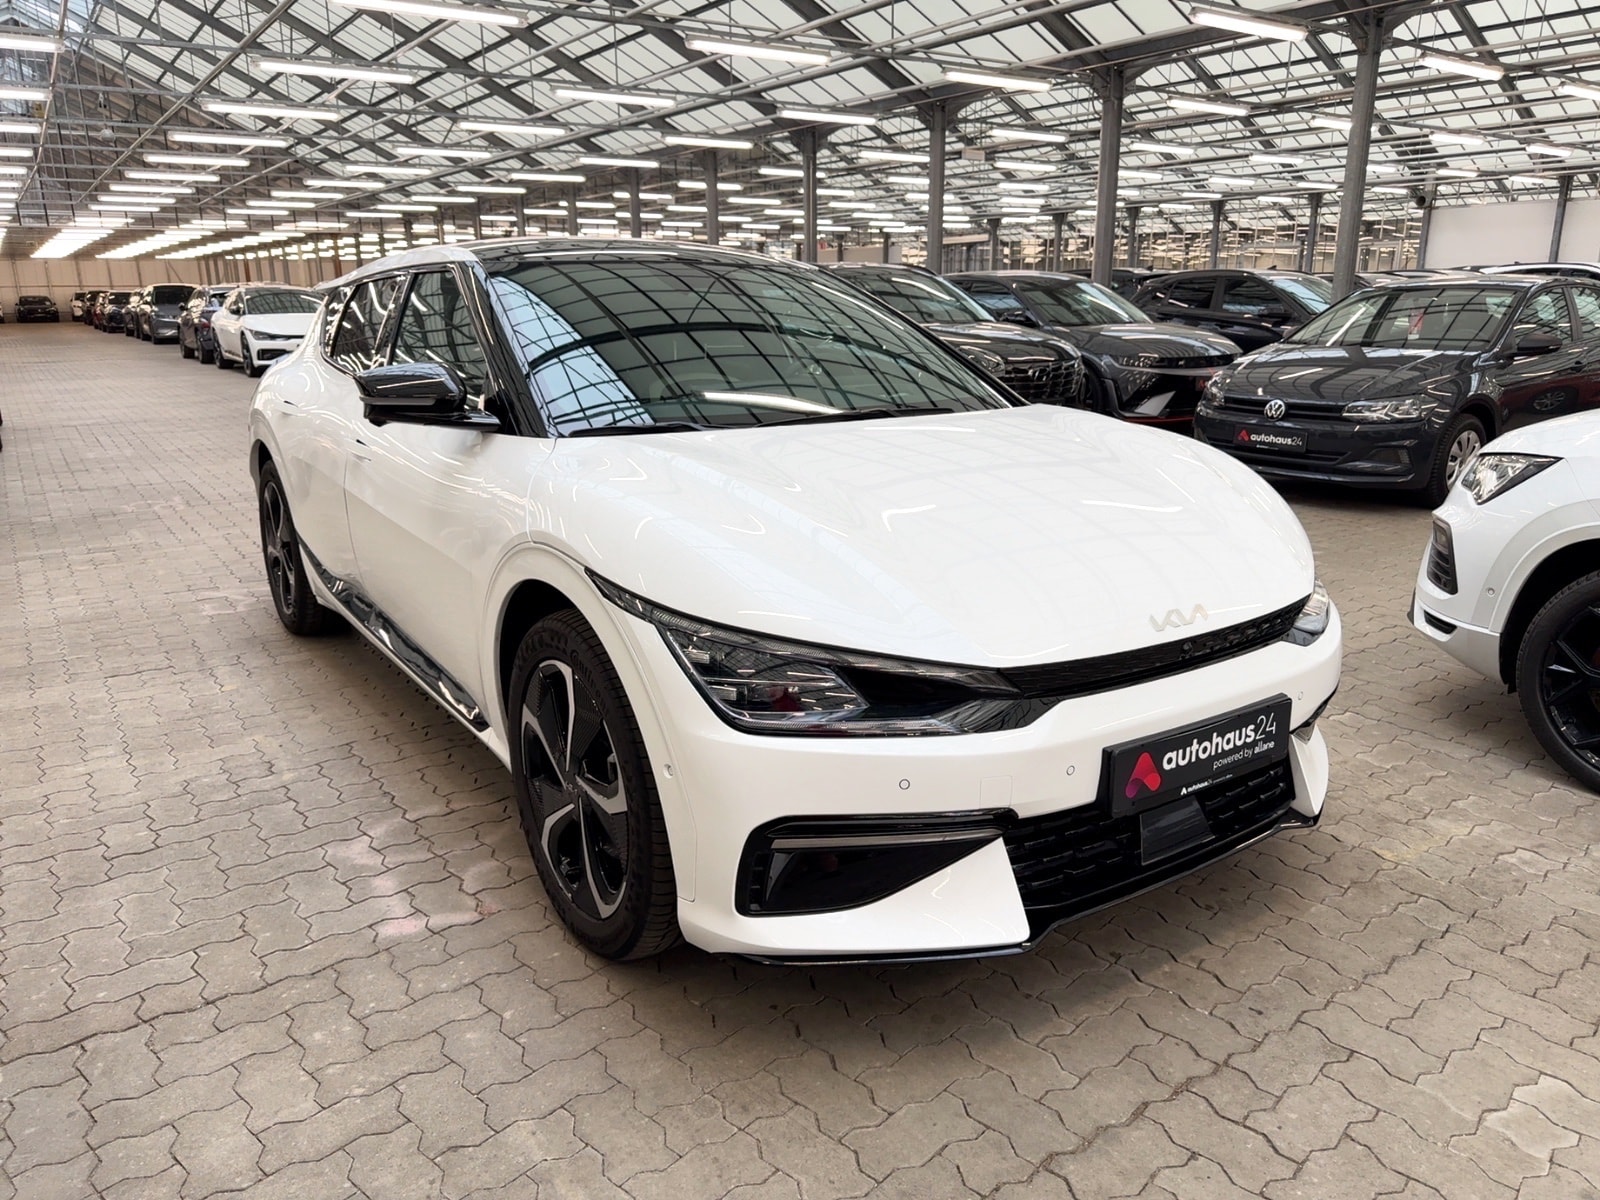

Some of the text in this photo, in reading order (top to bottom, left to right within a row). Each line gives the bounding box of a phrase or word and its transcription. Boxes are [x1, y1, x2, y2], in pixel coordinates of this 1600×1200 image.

[1250, 433, 1303, 446] autohaus24
[1162, 712, 1276, 770] autohaus24
[1213, 740, 1275, 771] powered by allane
